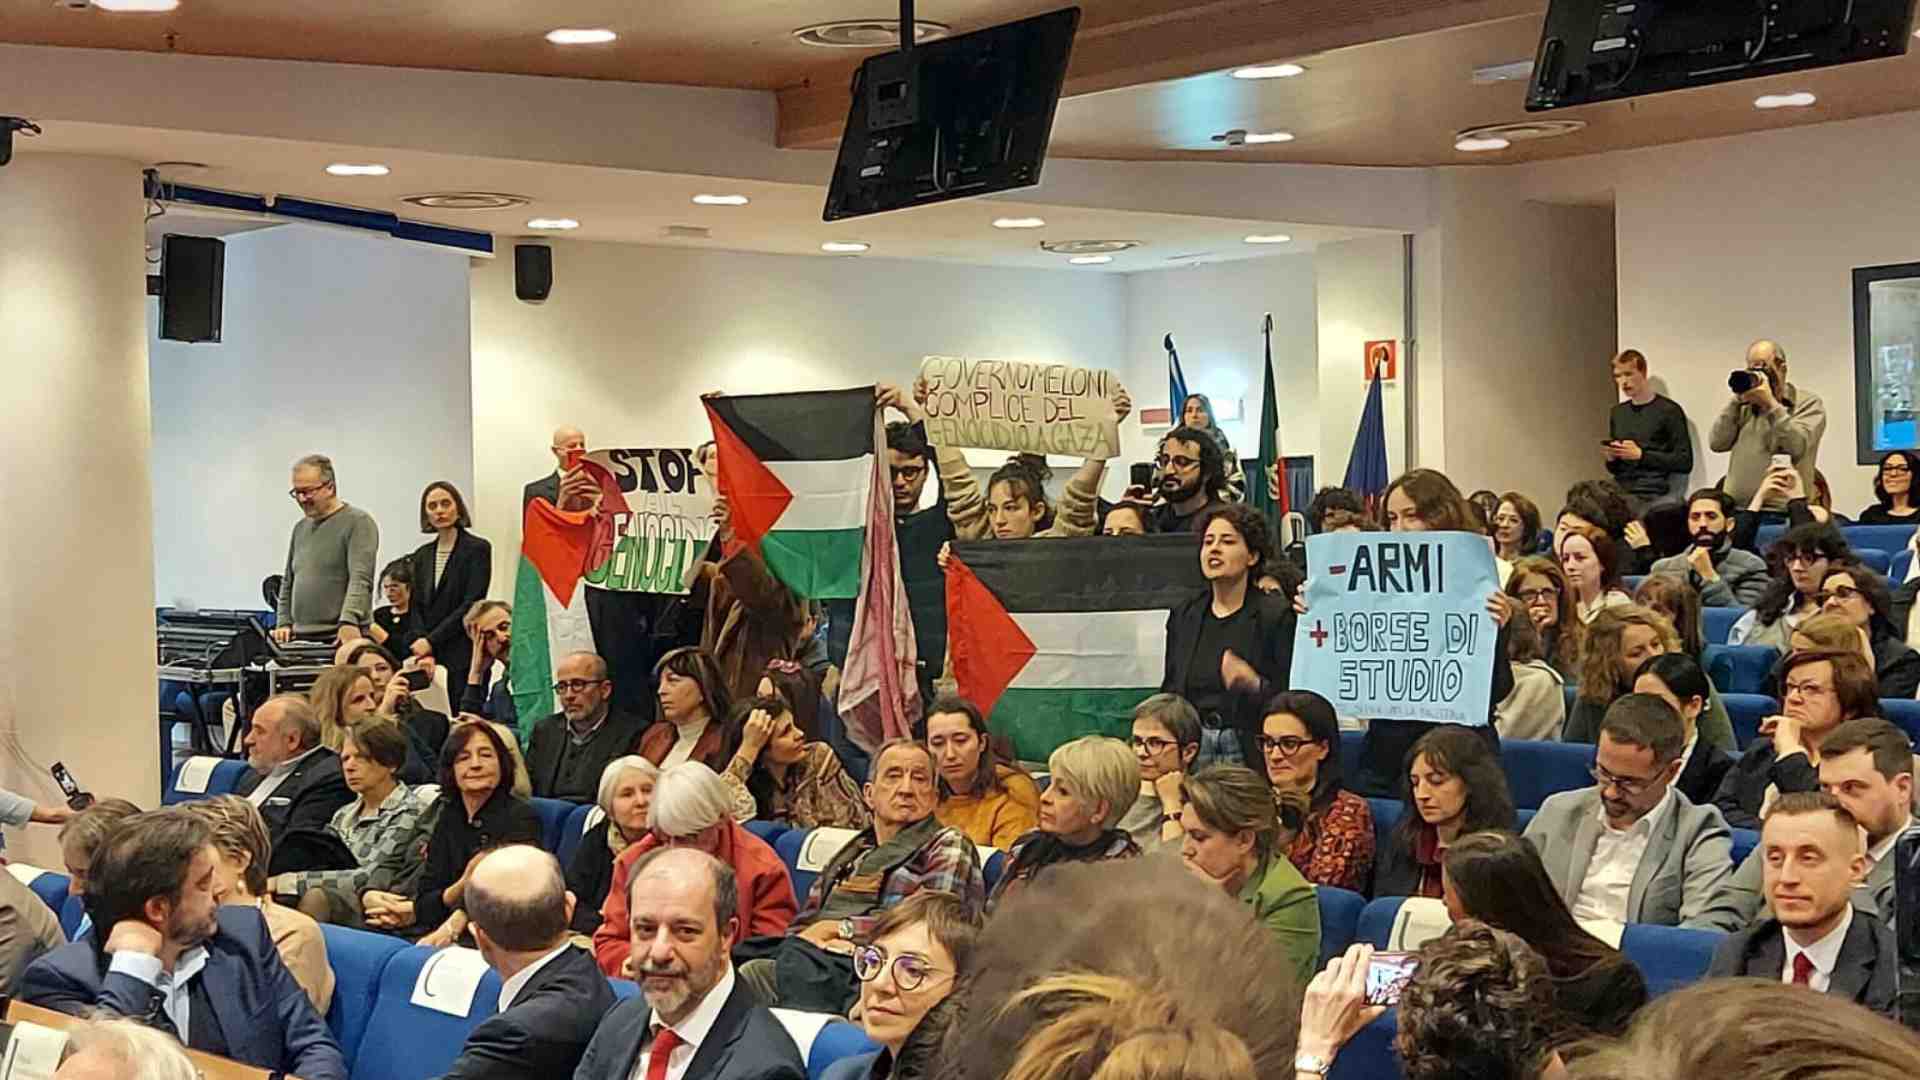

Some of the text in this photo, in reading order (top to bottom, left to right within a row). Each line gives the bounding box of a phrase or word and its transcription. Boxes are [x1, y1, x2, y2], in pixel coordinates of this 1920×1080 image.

[924, 391, 1086, 424] COMPLICE DEL
[1444, 612, 1479, 656] DI
[1338, 658, 1464, 703] STUDIO
